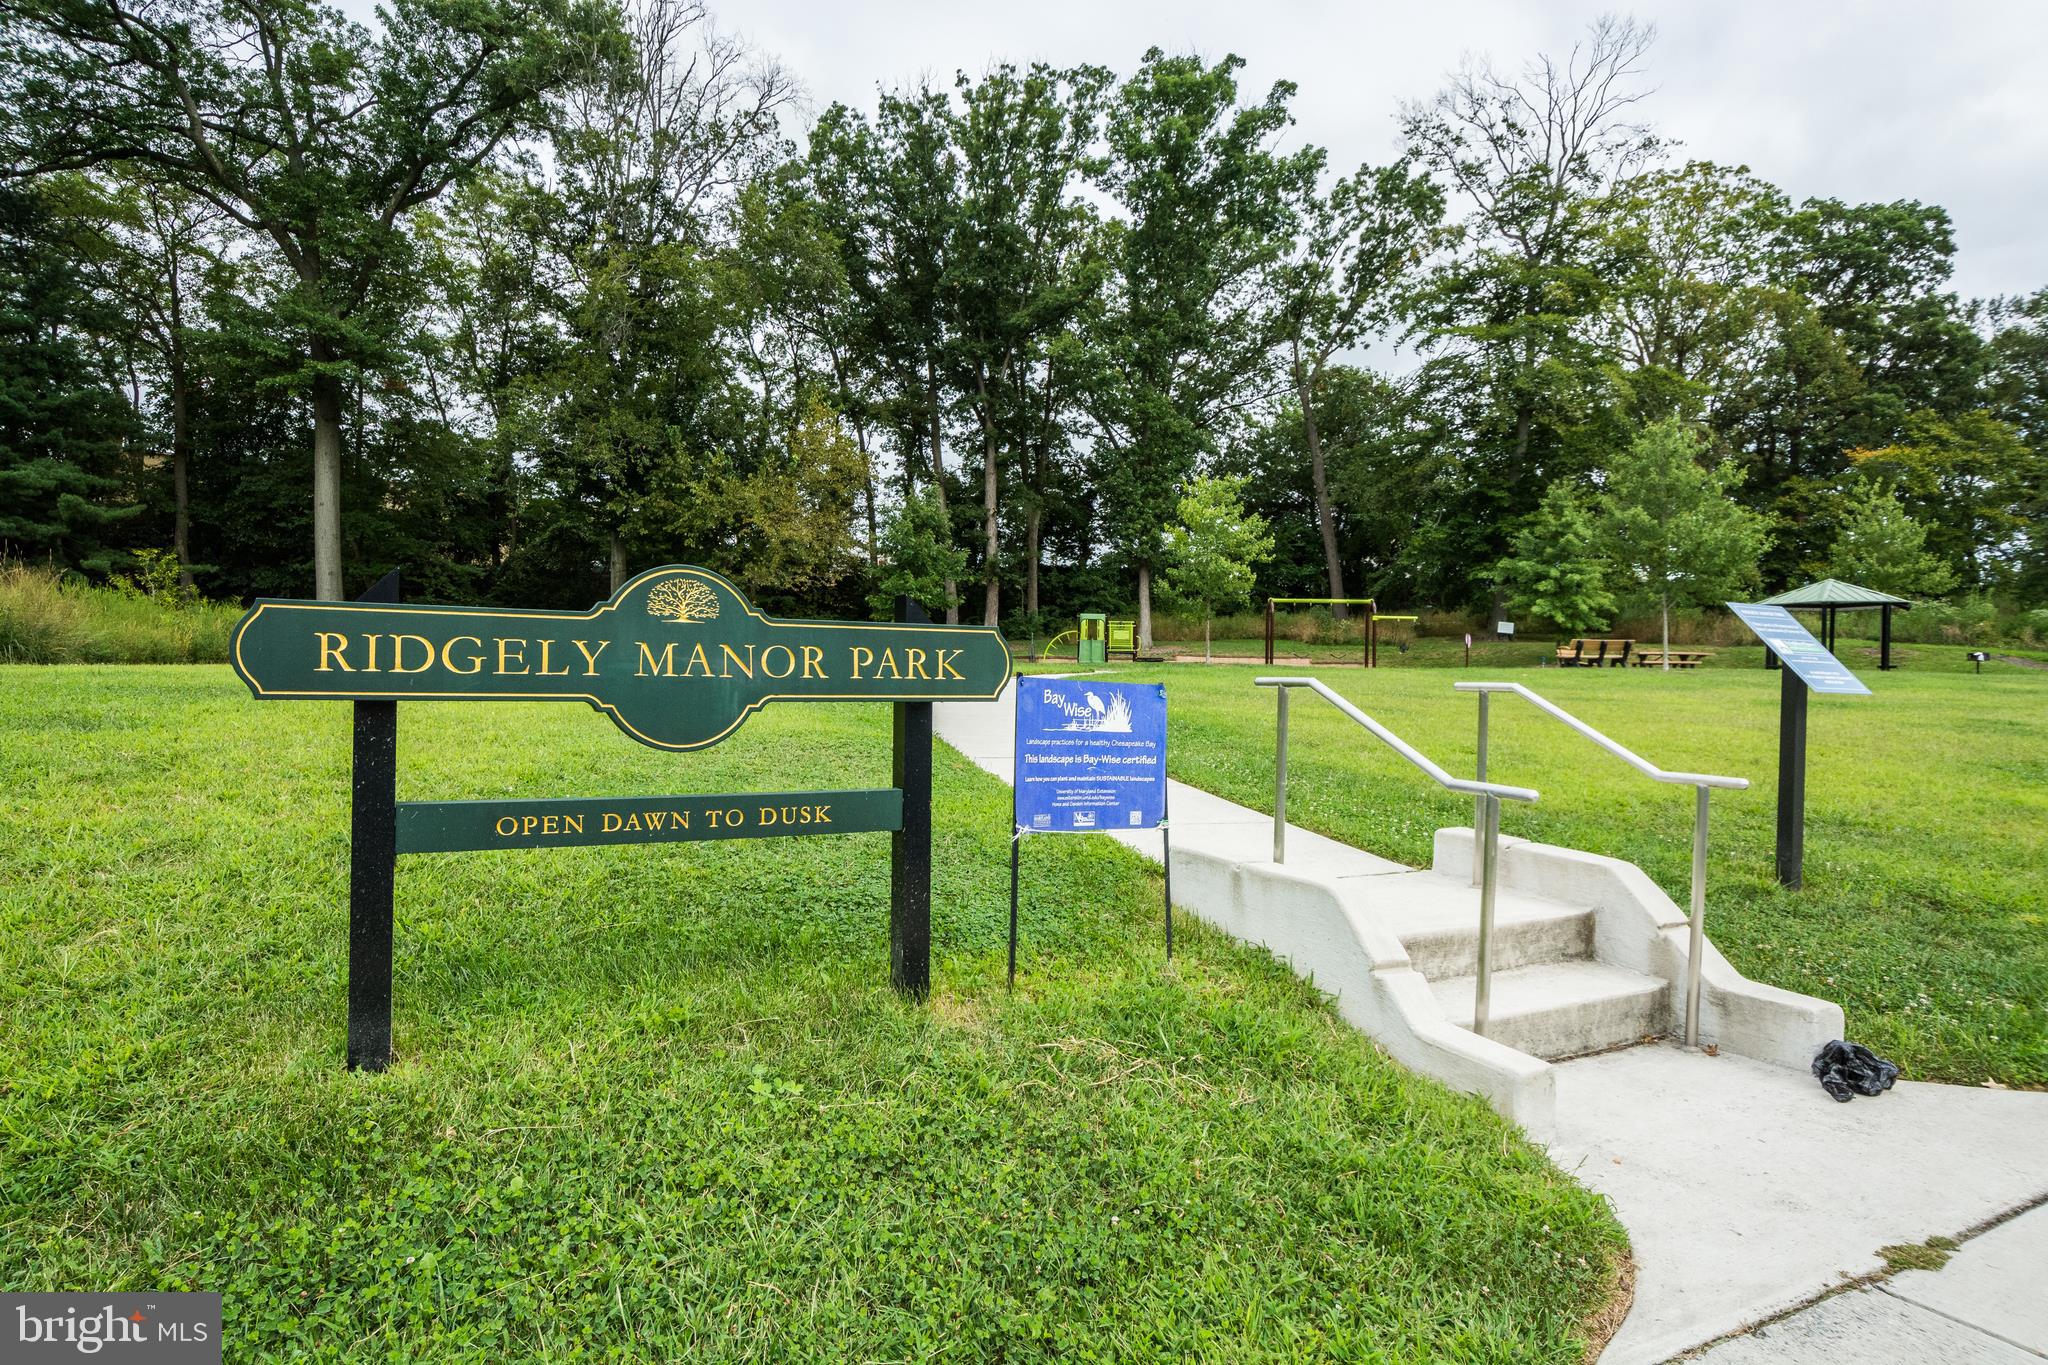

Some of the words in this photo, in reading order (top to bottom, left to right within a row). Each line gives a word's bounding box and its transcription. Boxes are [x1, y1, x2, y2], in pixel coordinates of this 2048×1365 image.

[313, 631, 611, 677] RIDGELY
[634, 641, 829, 680] MANOR
[849, 646, 966, 681] PARK
[1043, 689, 1066, 708] Bay
[1063, 702, 1092, 717] Wise
[1026, 738, 1051, 748] Landscape
[1051, 739, 1075, 748] practices
[1075, 738, 1084, 746] for
[1089, 739, 1111, 748] healthy
[1111, 740, 1144, 749] Chesapeake
[1145, 740, 1156, 749] Bay
[1025, 754, 1038, 764] This
[1039, 754, 1074, 767] landscape
[1074, 754, 1082, 764] is
[1083, 754, 1121, 766] Bay-Wise
[1122, 755, 1157, 765] certified
[495, 814, 584, 836] OPEN
[601, 811, 690, 833] DAWN
[705, 808, 745, 829] TO
[758, 805, 832, 826] DUSK
